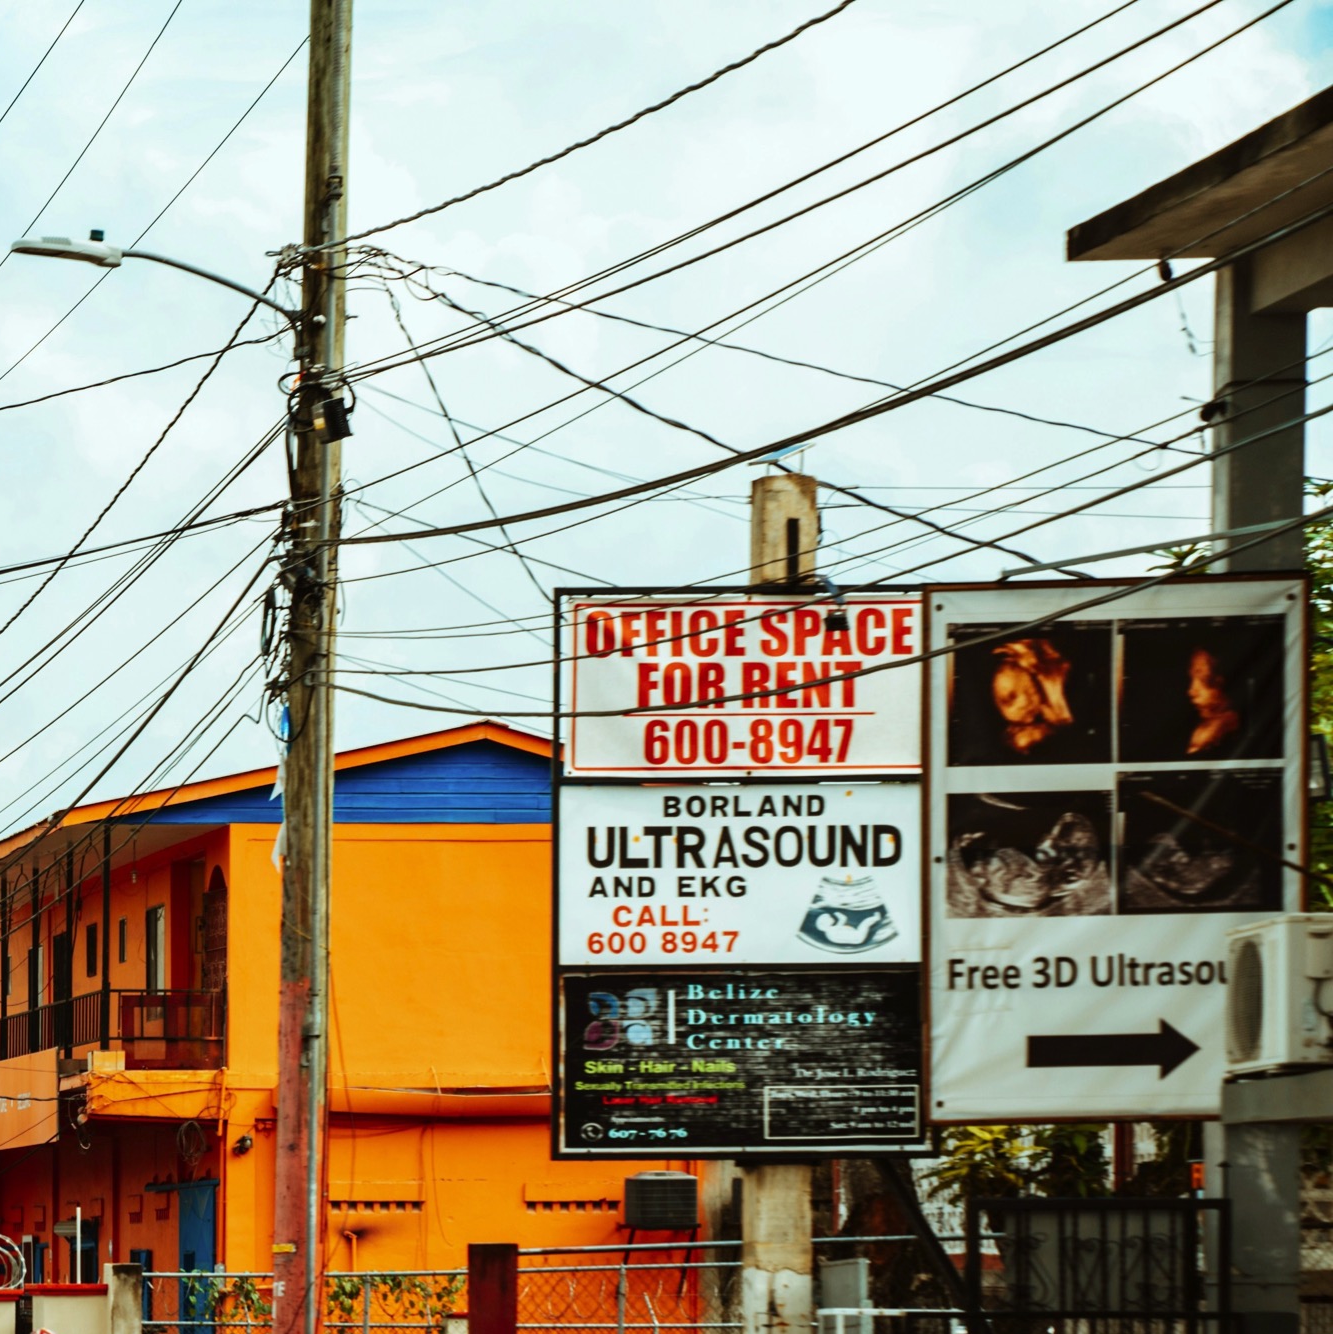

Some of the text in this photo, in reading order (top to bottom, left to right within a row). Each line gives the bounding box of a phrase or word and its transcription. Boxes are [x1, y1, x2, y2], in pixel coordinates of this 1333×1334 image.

[585, 608, 913, 658] OFFICE SPACE
[637, 661, 863, 708] FOR RENT
[644, 719, 854, 765] 600-8947
[663, 795, 825, 817] BORLAND
[587, 825, 902, 868] ULTRASOUND
[588, 876, 747, 898] AND EKG
[612, 905, 709, 927] CALL:
[588, 931, 740, 954] 600 8947
[948, 959, 1021, 990] Free
[1033, 956, 1078, 988] 3D
[687, 984, 780, 1000] Belize
[687, 1008, 876, 1027] Dermatology
[686, 1034, 785, 1050] Center
[584, 1061, 624, 1074] Skin
[639, 1060, 676, 1073] Hair
[691, 1060, 737, 1073] Nails
[575, 1081, 623, 1092] Sexually
